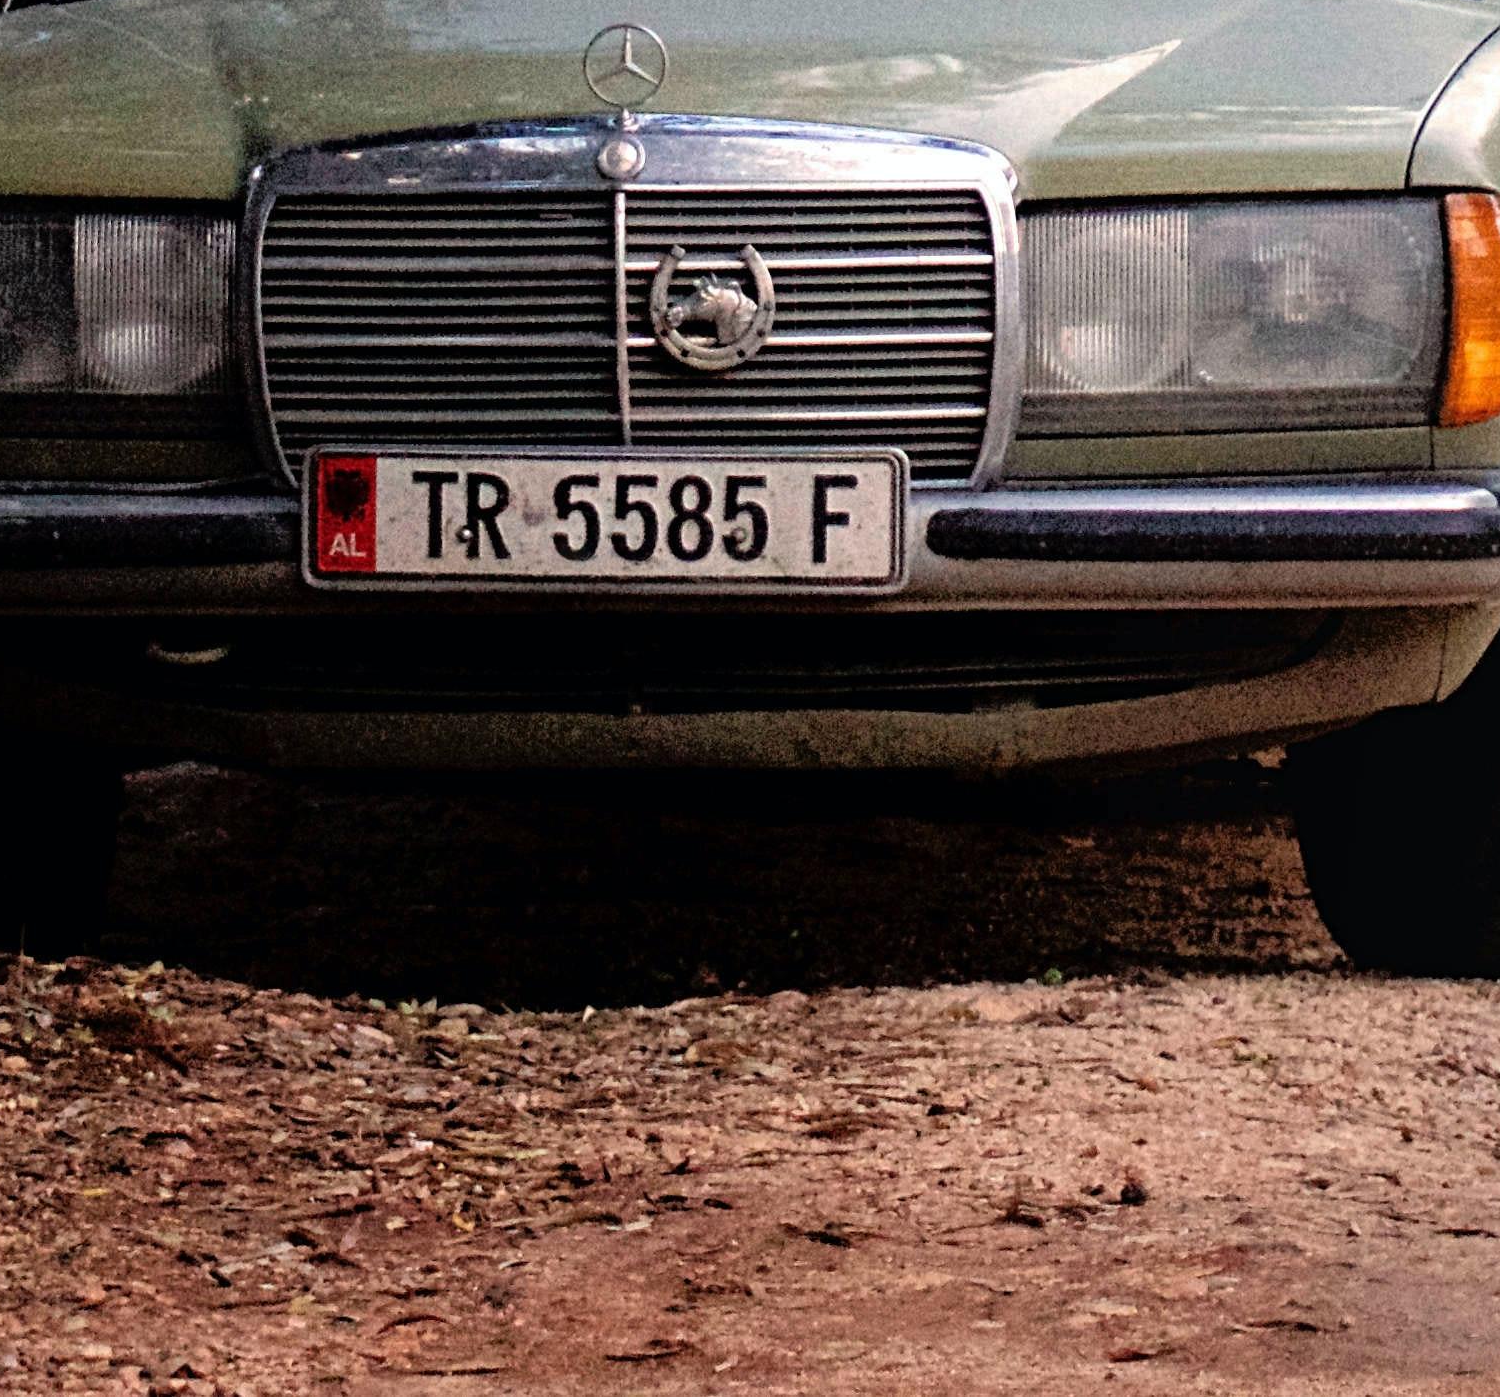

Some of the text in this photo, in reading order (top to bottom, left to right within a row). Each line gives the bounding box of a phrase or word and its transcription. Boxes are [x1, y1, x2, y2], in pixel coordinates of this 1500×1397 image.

[329, 532, 367, 558] AL
[412, 470, 858, 564] TR 5585 F
